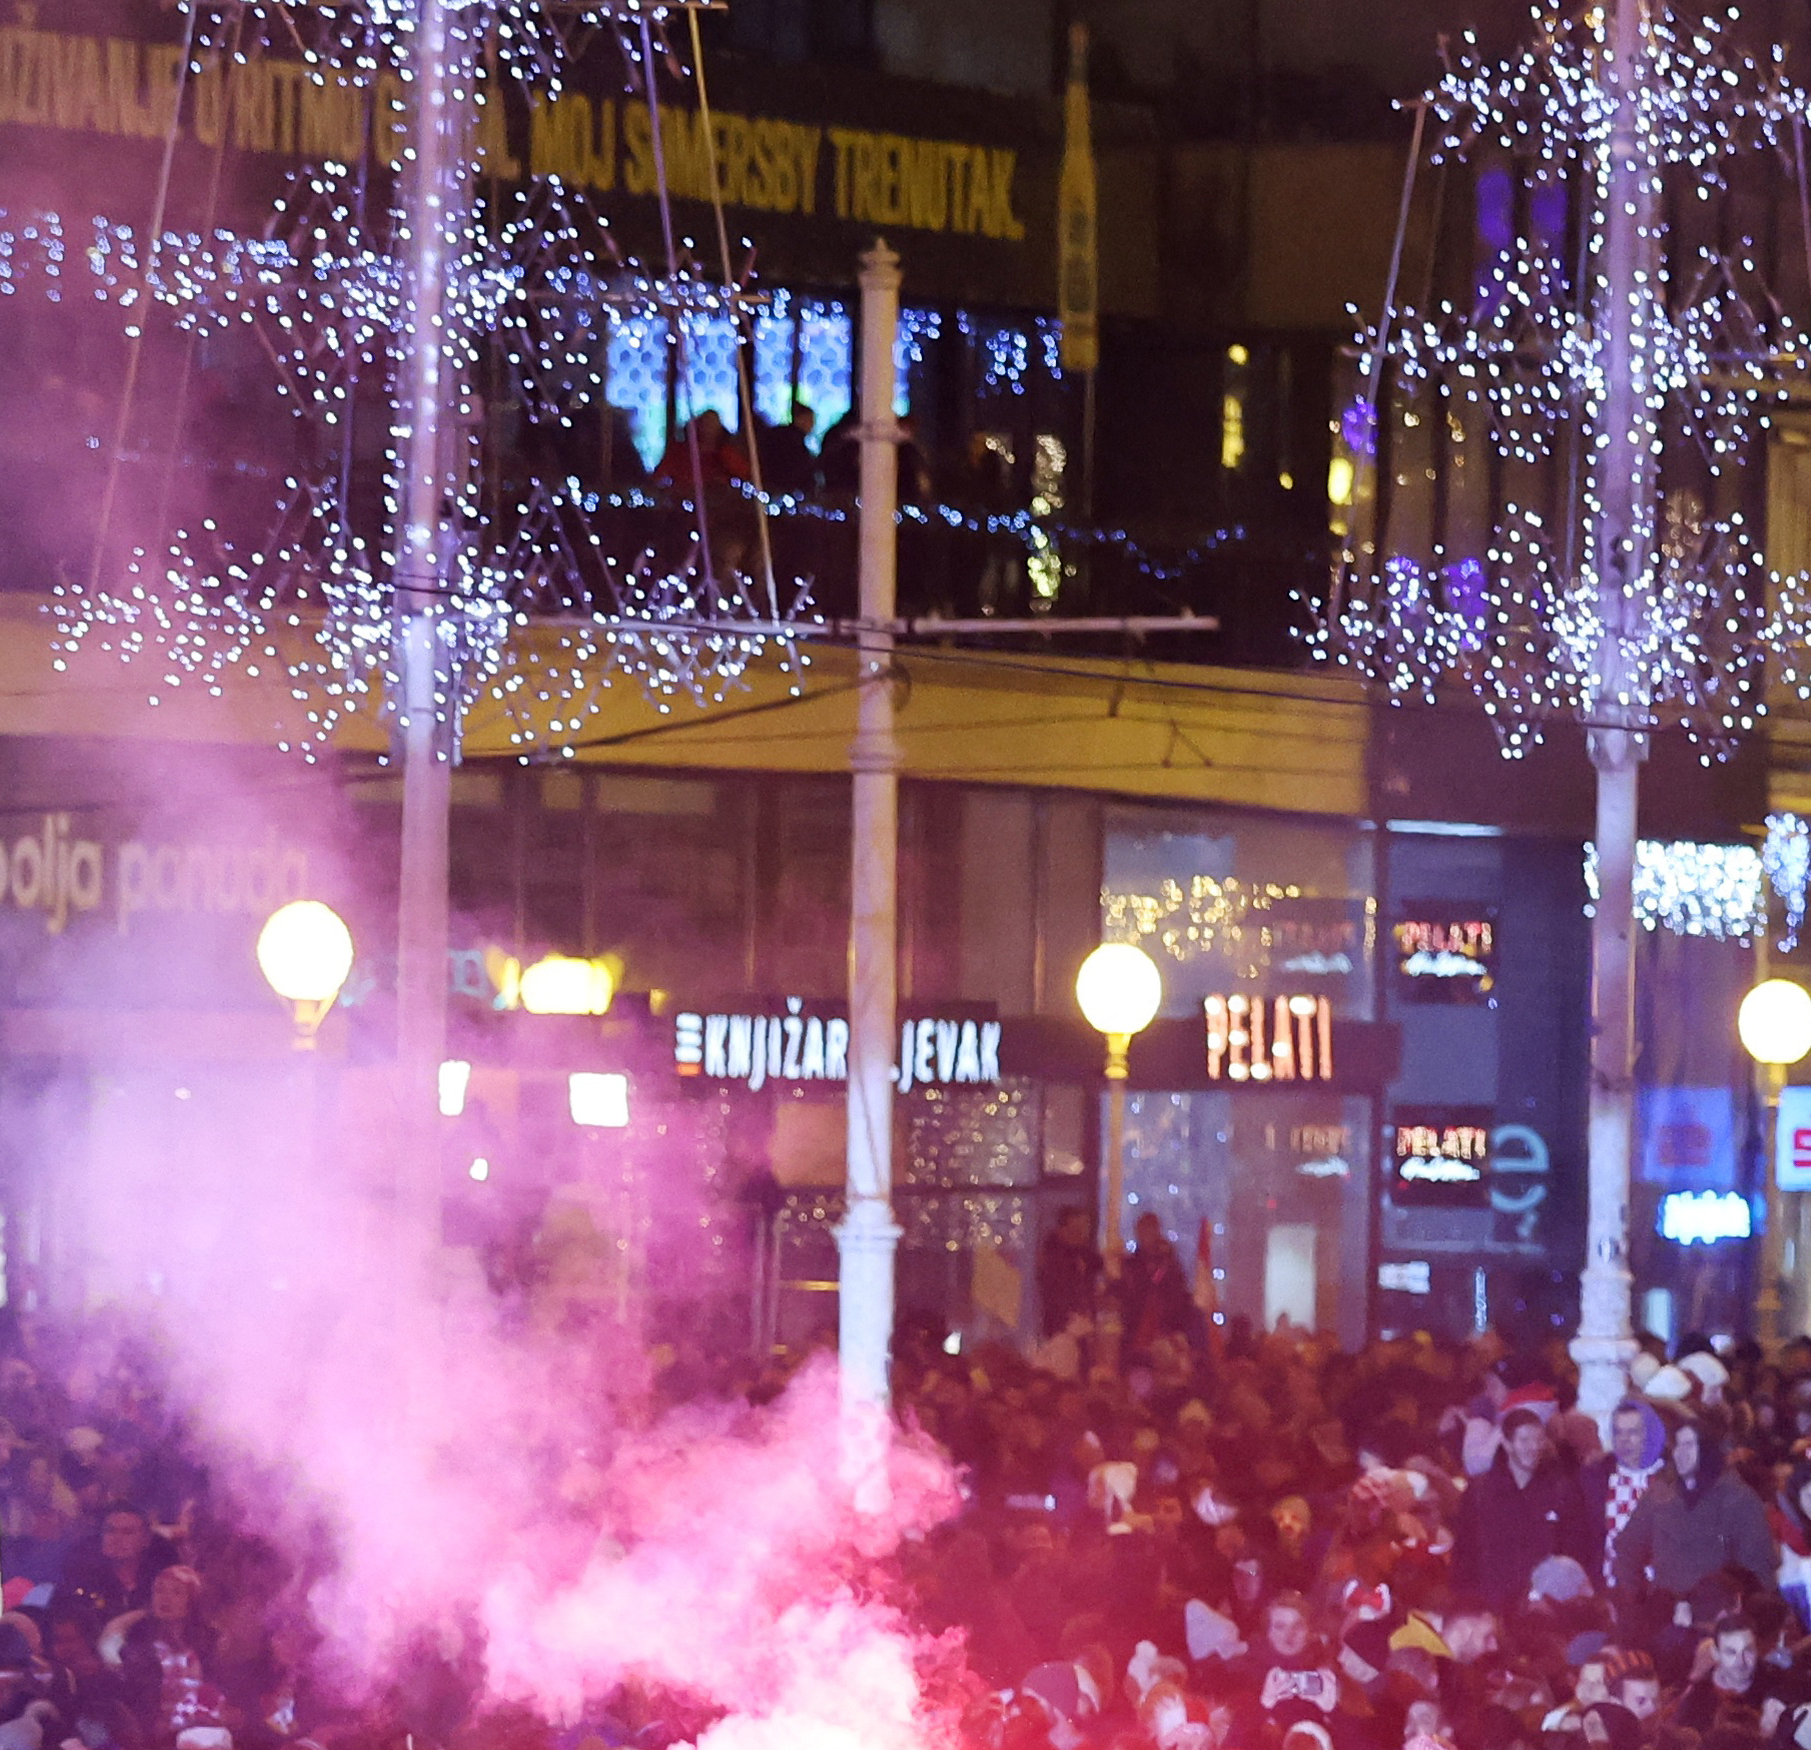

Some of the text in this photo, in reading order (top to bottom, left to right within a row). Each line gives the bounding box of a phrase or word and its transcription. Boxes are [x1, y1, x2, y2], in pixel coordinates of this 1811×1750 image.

[531, 88, 616, 192] MOJ
[117, 822, 309, 935] ponuda
[704, 995, 1002, 1094] KNJIŽAR JEVAK
[1204, 993, 1332, 1082] PELATI
